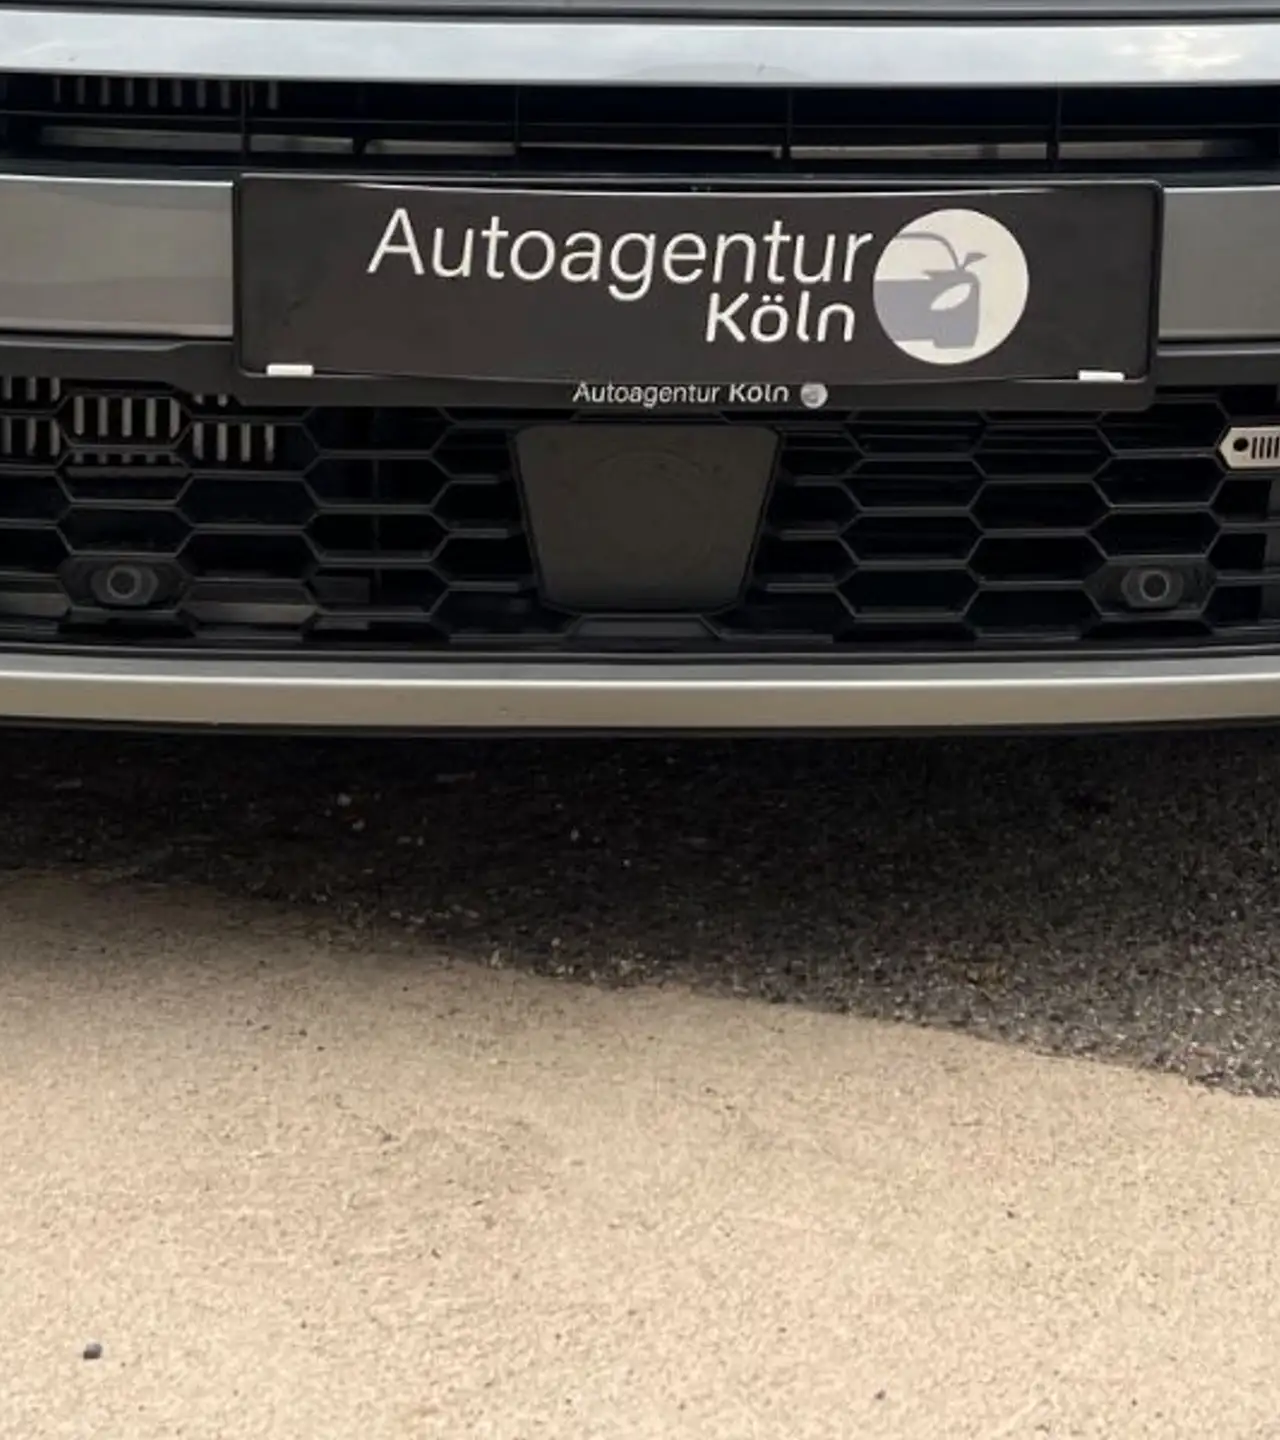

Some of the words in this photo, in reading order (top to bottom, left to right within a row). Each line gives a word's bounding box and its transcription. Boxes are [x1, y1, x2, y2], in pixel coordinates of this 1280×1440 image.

[367, 208, 872, 302] Autoagentur
[705, 292, 856, 344] Köln
[572, 381, 721, 408] Autoagentur
[728, 382, 789, 403] Köln
